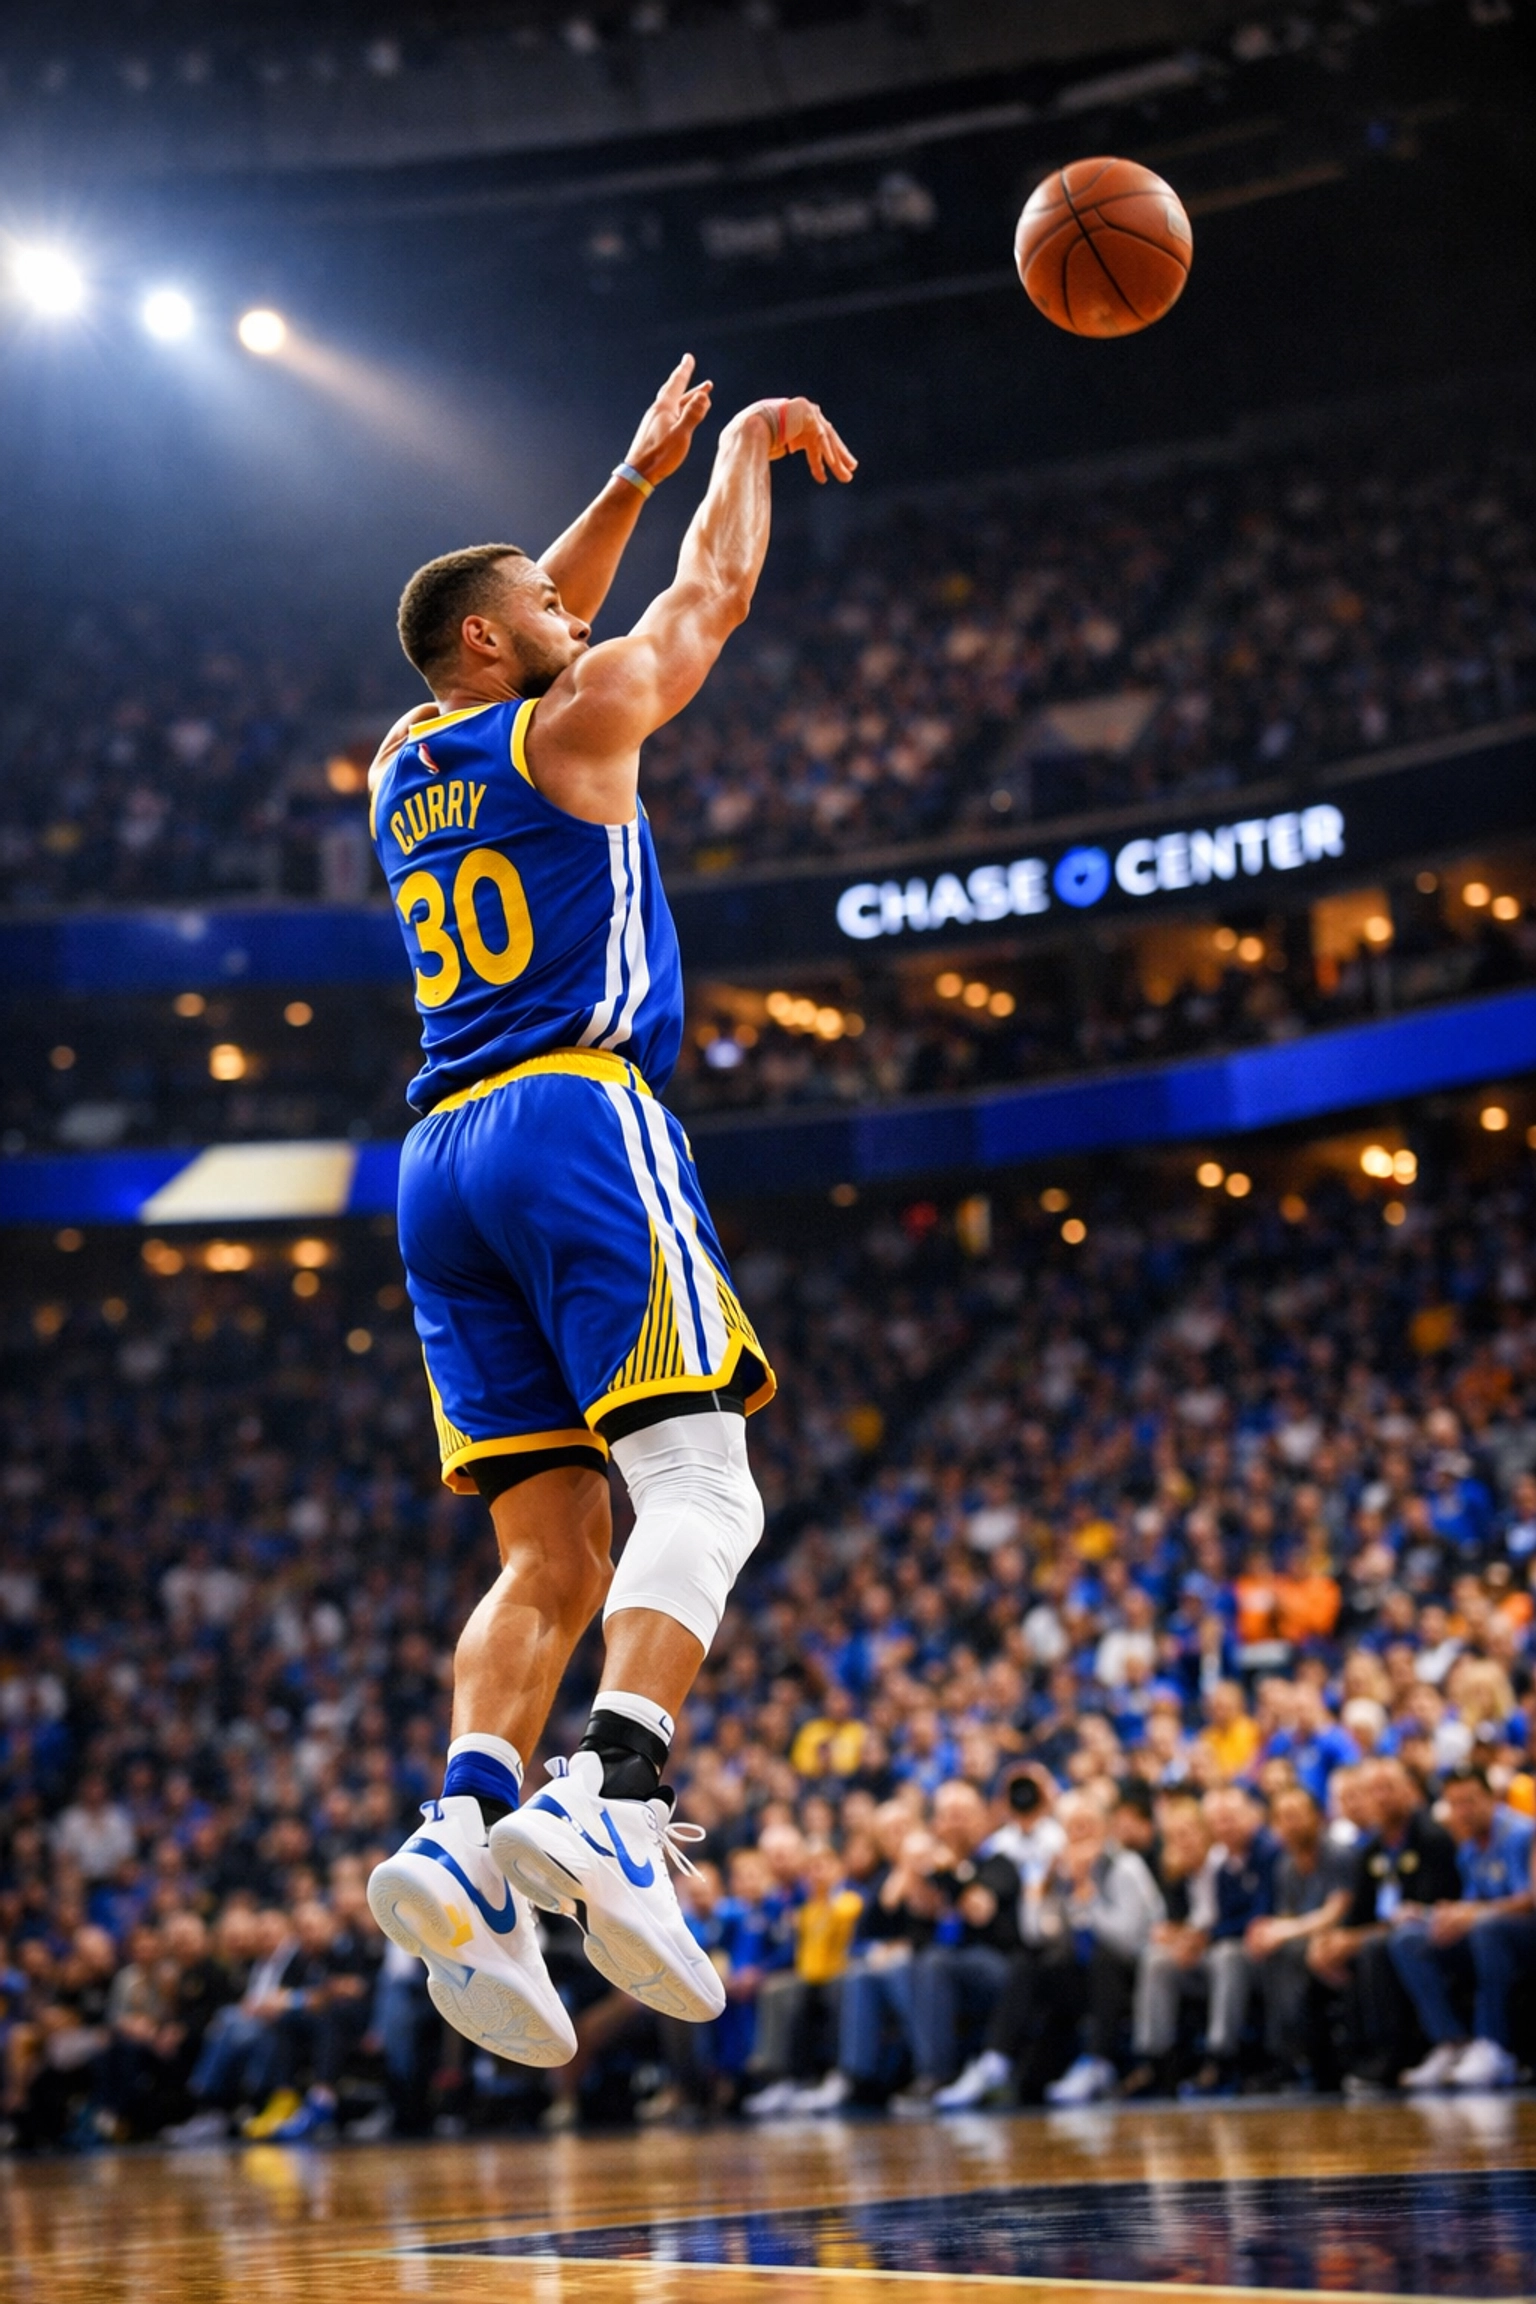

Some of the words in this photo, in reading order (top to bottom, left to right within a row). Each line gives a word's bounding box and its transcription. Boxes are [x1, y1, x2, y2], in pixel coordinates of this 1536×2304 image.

[390, 780, 486, 855] CURRY
[836, 858, 1050, 939] CHASE
[1114, 804, 1345, 896] CENTER
[396, 848, 533, 1008] 30
